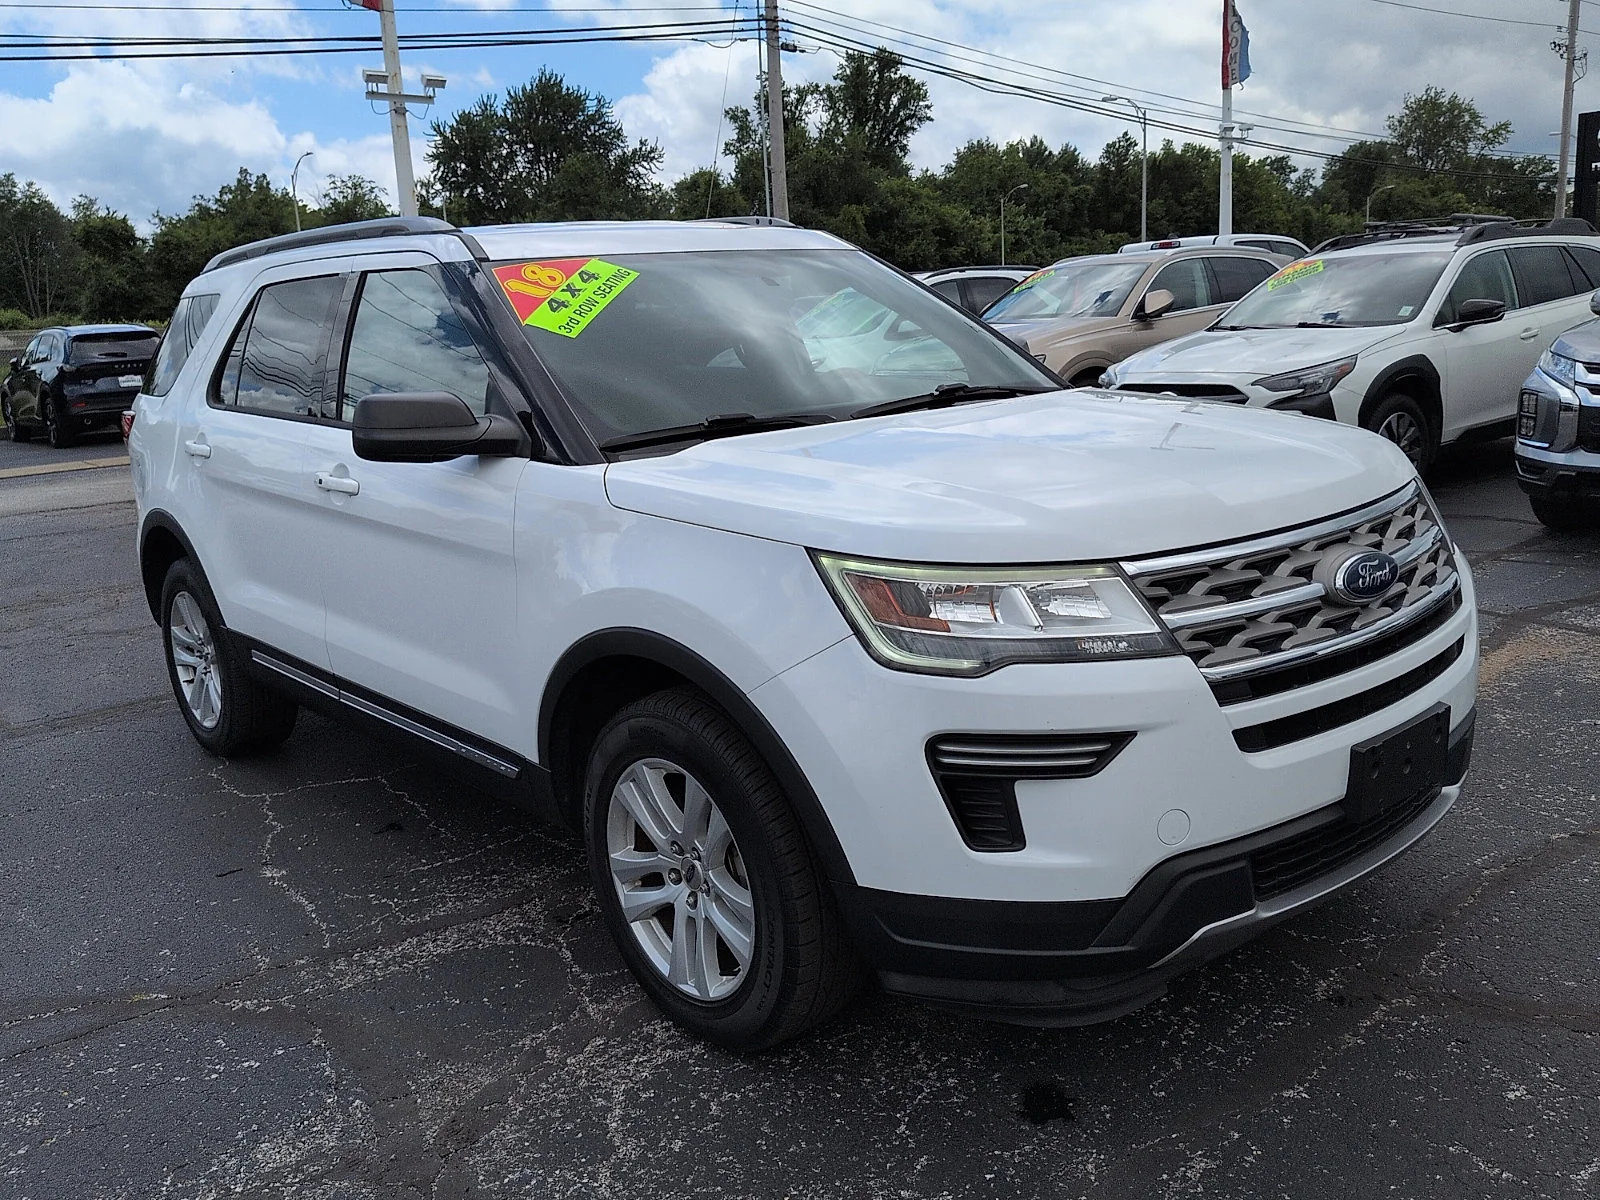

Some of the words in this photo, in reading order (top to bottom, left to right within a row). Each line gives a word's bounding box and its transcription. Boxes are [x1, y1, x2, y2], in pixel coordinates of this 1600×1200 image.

[504, 264, 566, 298] 18
[558, 316, 581, 334] 3rd
[573, 296, 600, 318] ROW
[593, 268, 632, 299] SEATING
[1358, 559, 1392, 588] Ford
